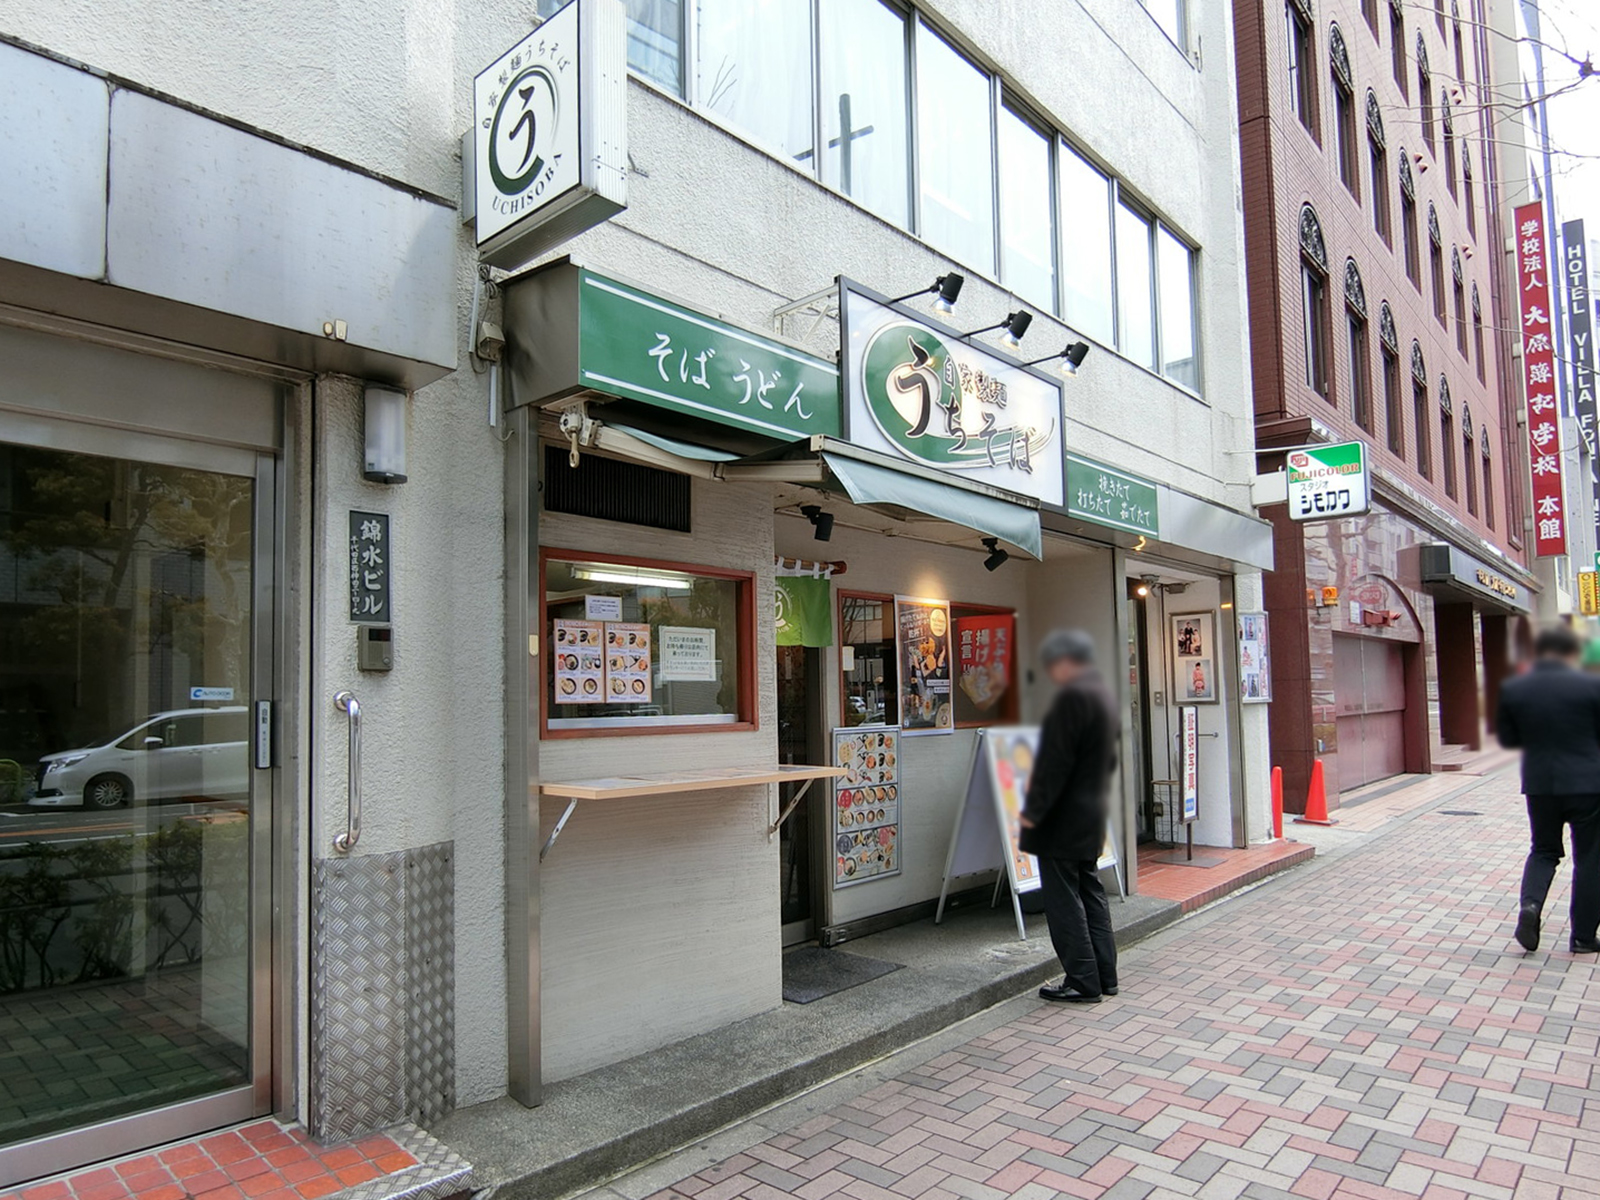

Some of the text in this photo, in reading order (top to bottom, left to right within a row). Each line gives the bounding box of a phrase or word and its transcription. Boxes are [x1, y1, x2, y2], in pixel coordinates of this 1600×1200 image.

[492, 151, 563, 215] UCHISOBA
[1567, 244, 1586, 314] HOTEL
[647, 331, 815, 421] そば うどん
[943, 354, 1008, 410] 自家製麺
[1520, 219, 1562, 540] 学校法人 大原簿記学校 本館
[1574, 332, 1593, 403] VILLA
[896, 335, 1037, 475] うちそば
[1077, 487, 1112, 516] 打ちたて
[1098, 473, 1130, 501] 挽きたて
[1290, 463, 1360, 482] FUJICOLOR
[1300, 480, 1329, 492] スタジオ
[1301, 489, 1351, 515] シモカワ
[360, 519, 384, 616] 錦水ビル
